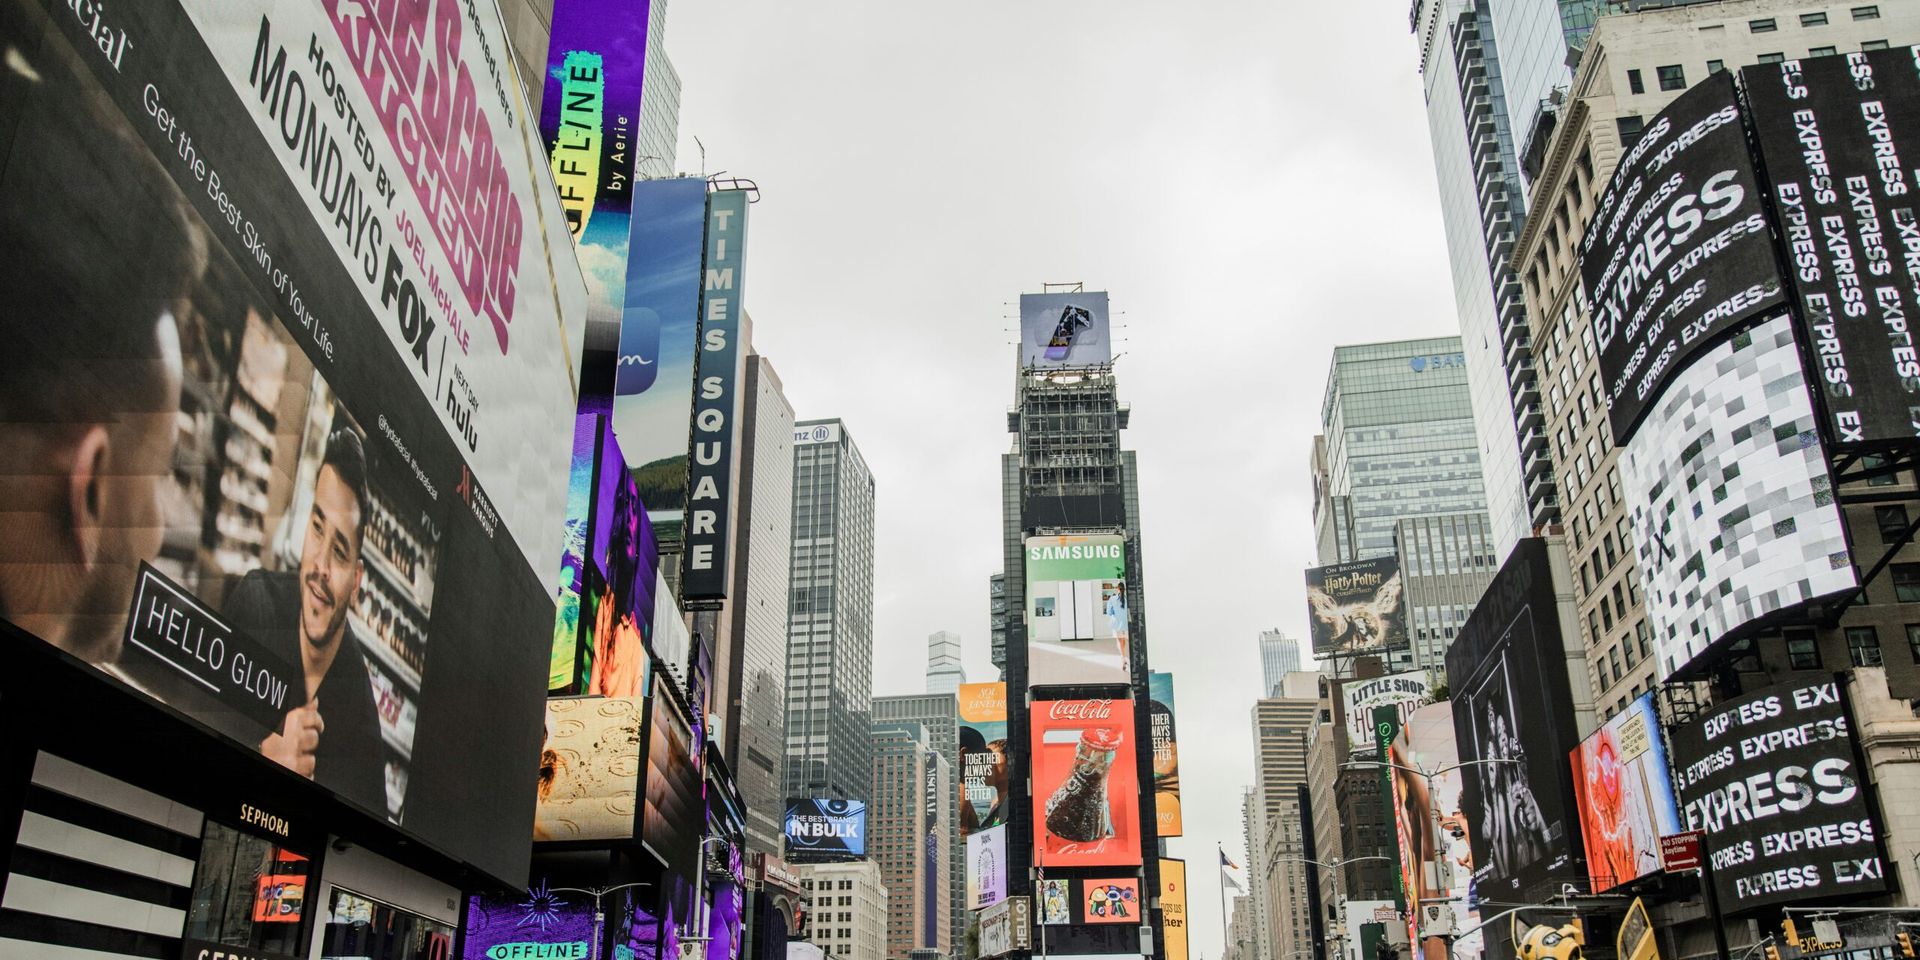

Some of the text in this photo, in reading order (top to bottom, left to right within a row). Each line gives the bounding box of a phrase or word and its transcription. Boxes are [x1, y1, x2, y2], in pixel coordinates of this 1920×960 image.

[496, 73, 514, 129] here
[607, 116, 629, 191] by Aerie
[1615, 116, 1671, 191] EXPRESS
[1860, 100, 1908, 197] EXPRESS
[249, 13, 436, 377] MONDAYS FOX
[308, 32, 470, 356] HOSTED BY JOEL McHALE
[1605, 104, 1739, 247] EXPRESS EXPRESS
[144, 83, 335, 364] Get the Best Skin of Your Life.
[1668, 213, 1767, 285] EXPRESS
[1777, 182, 1822, 283] EXPRESS
[1845, 175, 1892, 277] EXPRESS
[705, 209, 734, 352] TIMES
[1594, 169, 1745, 356] EXPRESS
[1594, 241, 1626, 304] EXPRESS
[1820, 215, 1867, 318] EXPRESS
[454, 363, 479, 413] NEXT DAY
[1613, 341, 1647, 399] EXPRESS
[1637, 339, 1678, 401] EXPRESS
[446, 378, 478, 453] hulu
[691, 375, 725, 570] SQUARE
[471, 501, 494, 539] MARQUIS
[473, 485, 499, 528] MARRIOTT
[1031, 544, 1121, 561] SAMSUNG
[1325, 571, 1382, 594] Harry Potter
[147, 595, 288, 710] HELLO GLOW
[1049, 698, 1113, 720] Coca-Cola
[1352, 679, 1425, 706] LITTLE SHOP
[1703, 696, 1782, 741] EXPRESS
[964, 752, 1001, 766] TOGETHER
[964, 764, 993, 777] ALWAYS
[964, 776, 986, 789] FEELS
[1686, 746, 1735, 785] EXPRESS
[239, 803, 290, 837] SEPHORA
[791, 814, 859, 824] THE BEST BRANDS
[964, 788, 992, 801] BETTER
[1683, 758, 1857, 834] EXPRESS
[791, 822, 858, 838] IN BULK
[1662, 833, 1698, 847] NO STOPPING
[1663, 845, 1687, 856] Anytime
[1761, 818, 1875, 856] EXPRESS
[1016, 899, 1028, 947] HELLO!
[495, 944, 580, 960] OFFLINE
